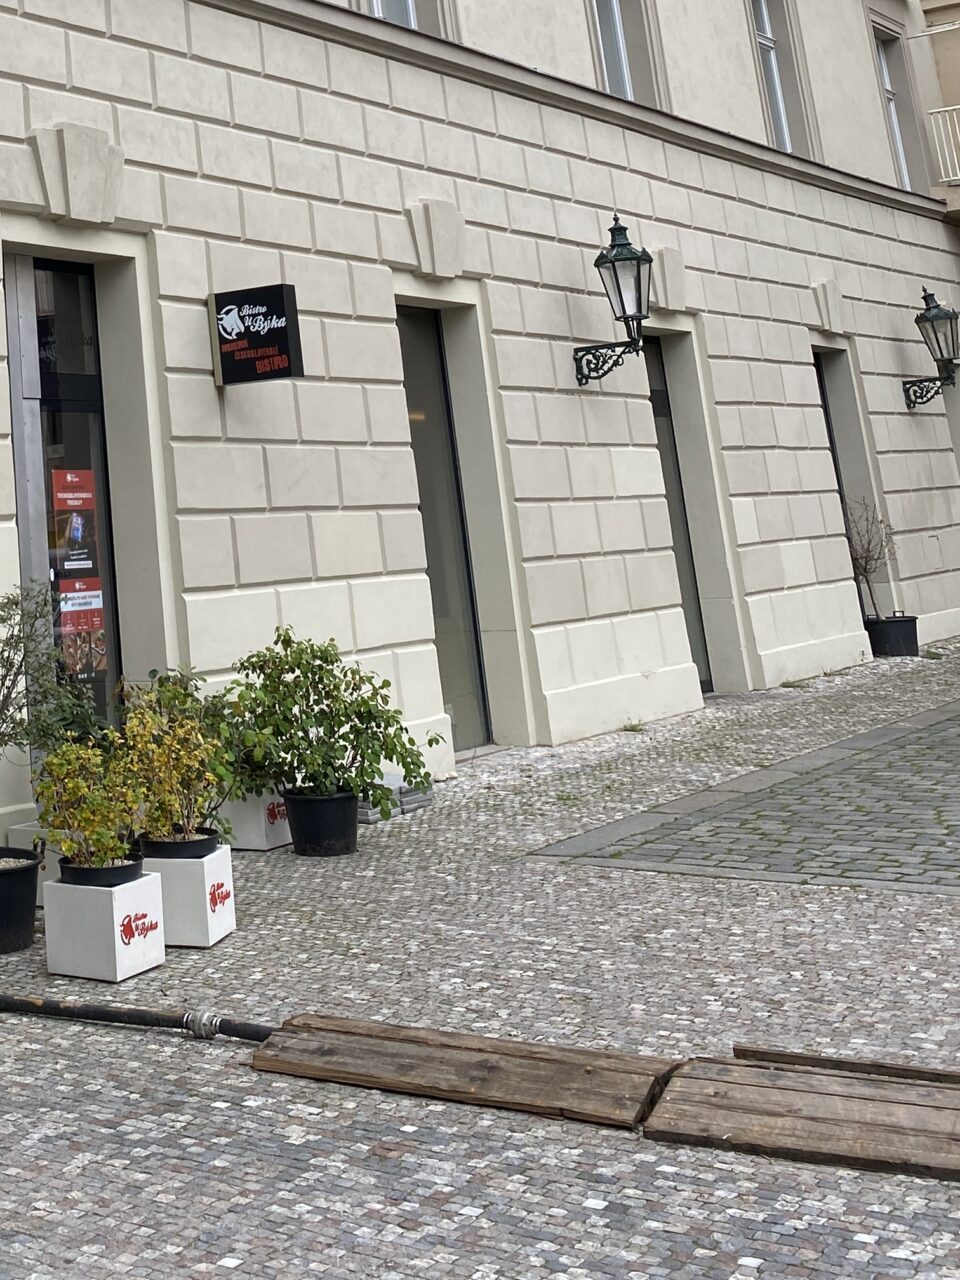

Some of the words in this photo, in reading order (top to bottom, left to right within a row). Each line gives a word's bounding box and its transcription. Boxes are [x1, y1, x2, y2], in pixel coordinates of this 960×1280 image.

[240, 304, 267, 316] Bistro
[250, 315, 286, 335] Býka
[256, 354, 288, 373] BISTRO
